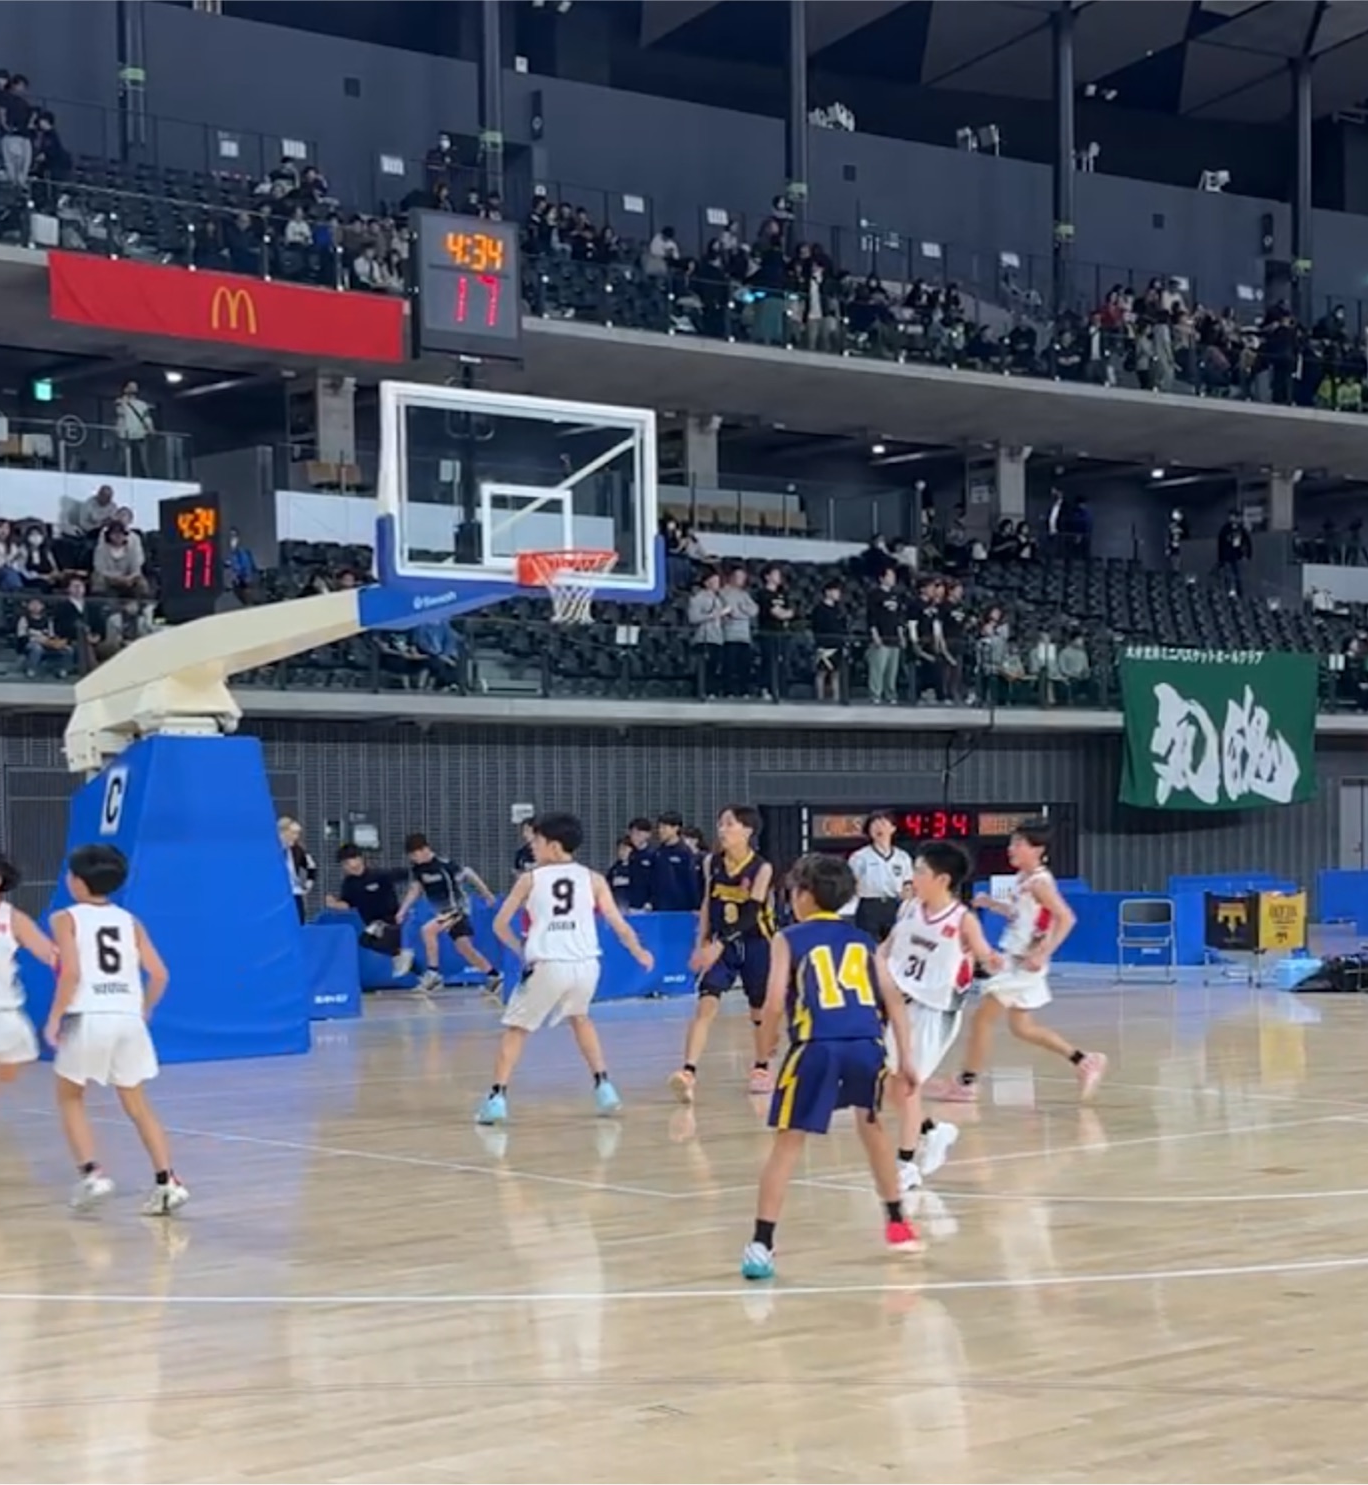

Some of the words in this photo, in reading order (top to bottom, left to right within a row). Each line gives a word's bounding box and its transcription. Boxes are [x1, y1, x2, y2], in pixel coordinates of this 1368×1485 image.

[446, 233, 504, 271] 4:34
[454, 275, 500, 327] 17
[177, 507, 216, 541] 4:34
[184, 541, 215, 589] 17
[105, 777, 122, 825] C
[905, 811, 969, 838] 4:34
[552, 877, 575, 916] 9
[96, 926, 122, 974] 6
[904, 955, 926, 981] 31
[810, 943, 876, 1010] 14
